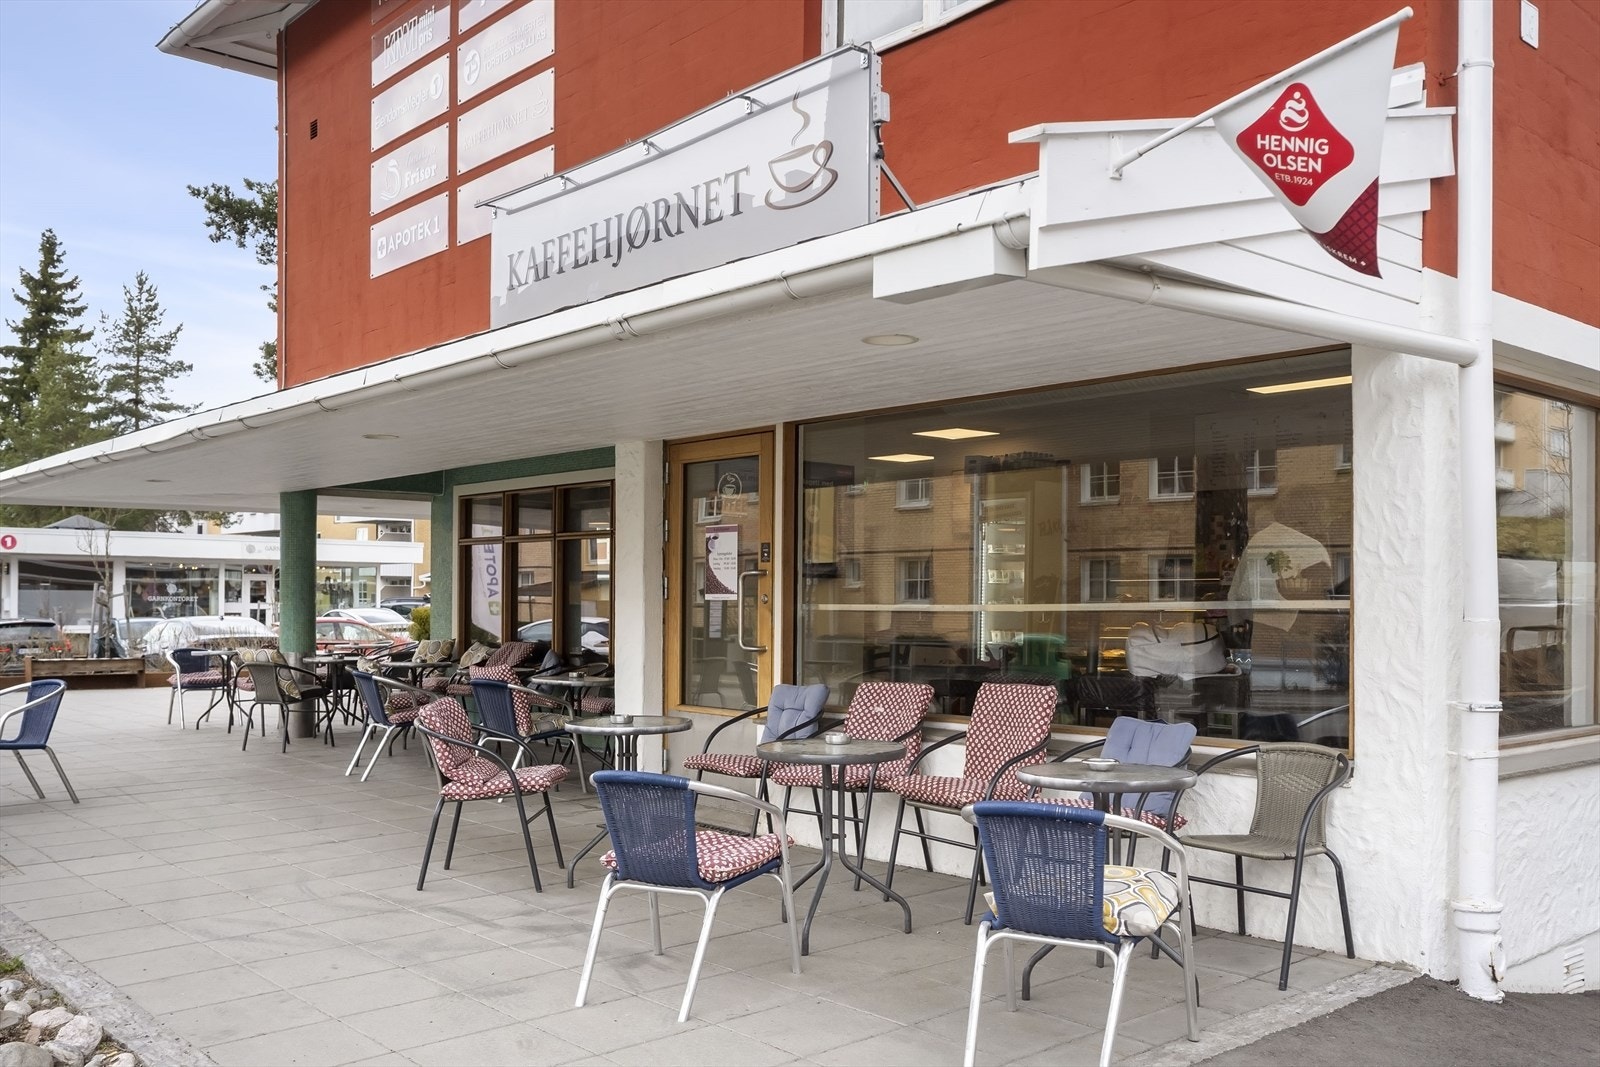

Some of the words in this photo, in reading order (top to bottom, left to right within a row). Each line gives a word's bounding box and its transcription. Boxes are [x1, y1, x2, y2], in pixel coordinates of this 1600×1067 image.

[418, 5, 435, 27] mini
[384, 16, 418, 69] KIWI
[418, 31, 433, 48] pris
[1256, 133, 1329, 155] HENNIG
[1263, 153, 1322, 173] OLSEN
[1274, 172, 1314, 186] ETB.1924
[388, 222, 431, 254] APOTEK
[433, 216, 440, 234] 1
[507, 164, 751, 291] KAFFEHJØRNET
